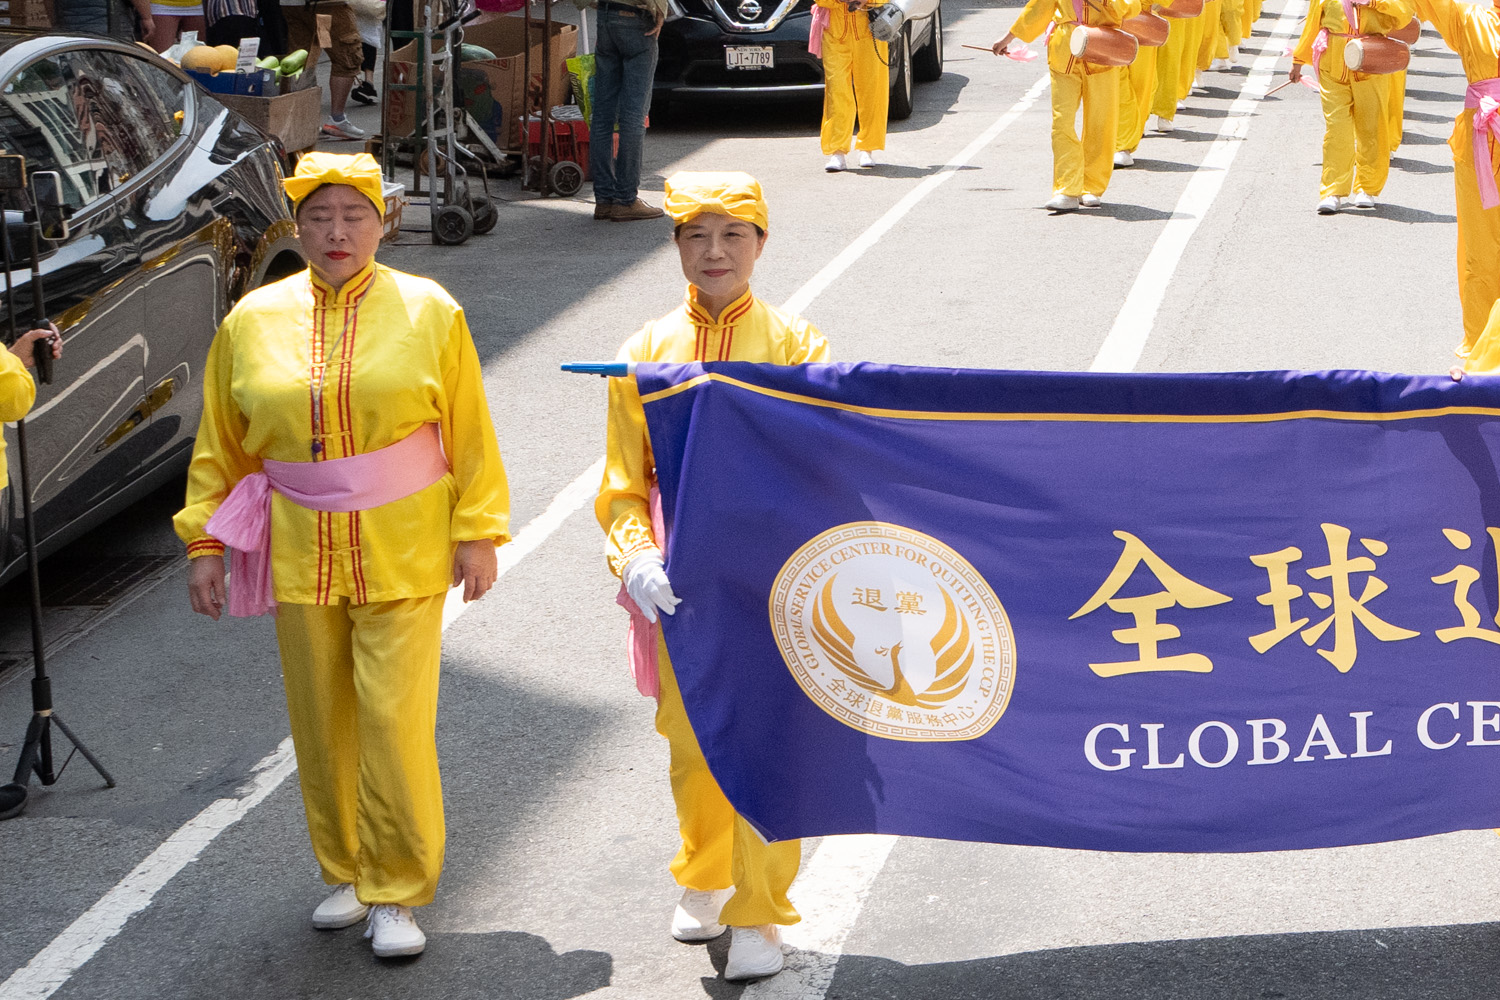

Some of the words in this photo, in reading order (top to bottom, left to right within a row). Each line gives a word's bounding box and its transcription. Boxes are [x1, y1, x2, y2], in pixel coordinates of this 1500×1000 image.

[729, 52, 743, 65] LJT
[750, 52, 770, 64] 7789
[830, 542, 891, 566] CENTER
[895, 545, 927, 568] FOR
[790, 558, 832, 617] SERVICE
[850, 587, 927, 616] 退黨
[929, 561, 989, 631] QUITTING
[793, 617, 820, 670] GLOBAL
[982, 632, 995, 666] THE
[979, 667, 995, 698] CCP
[826, 678, 976, 728] 全球退黨服務中心
[1083, 711, 1393, 772] GLOBAL
